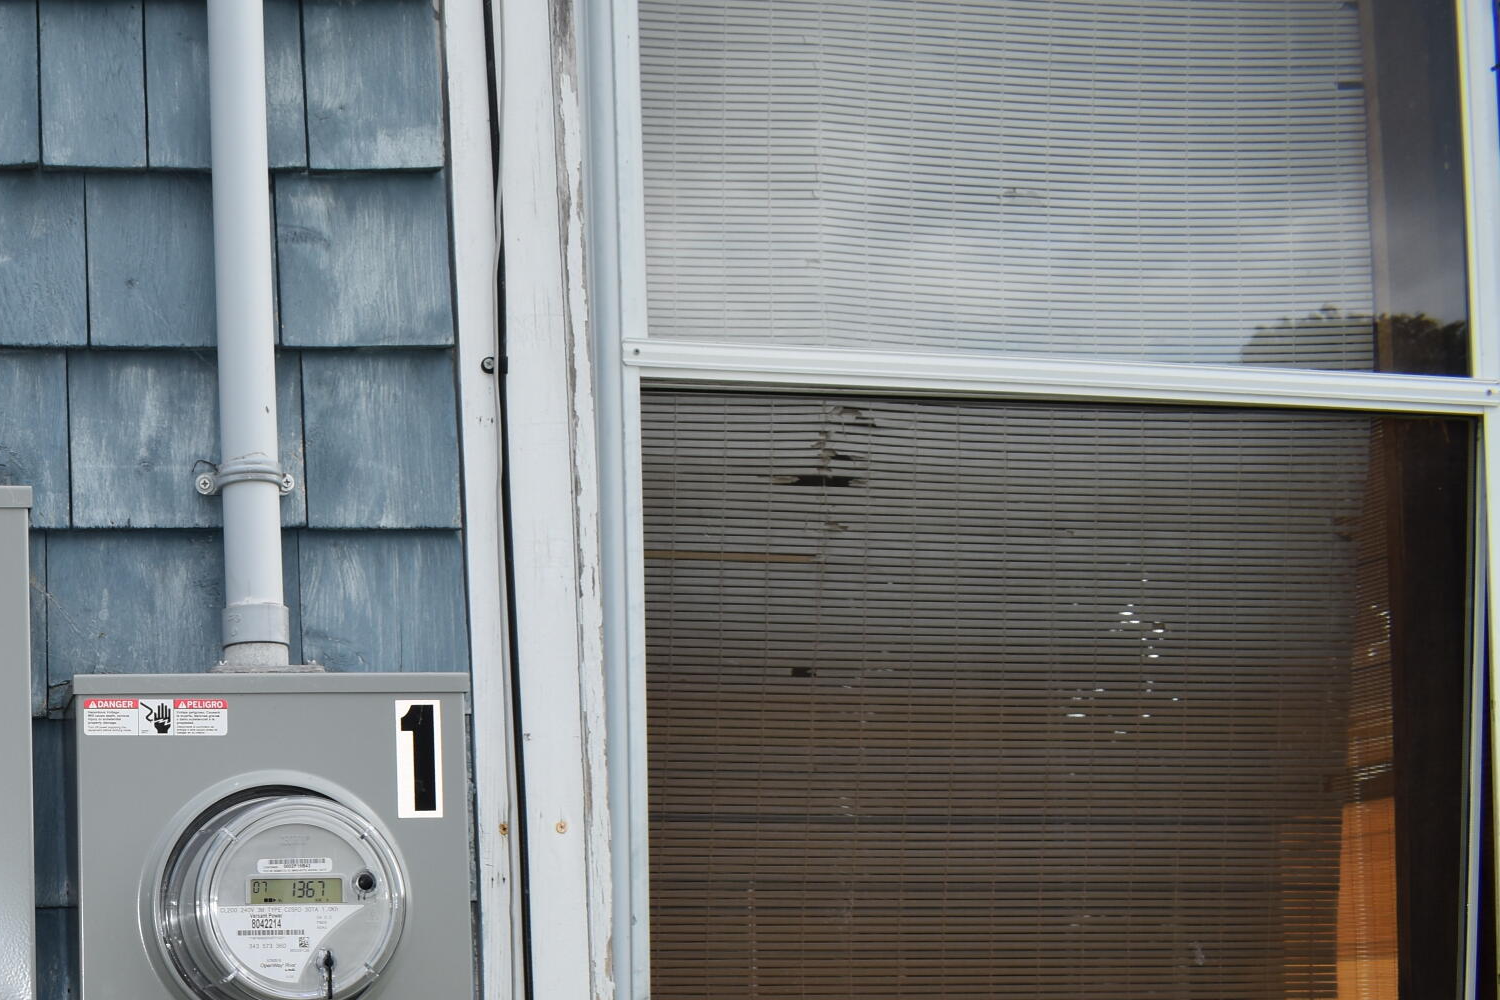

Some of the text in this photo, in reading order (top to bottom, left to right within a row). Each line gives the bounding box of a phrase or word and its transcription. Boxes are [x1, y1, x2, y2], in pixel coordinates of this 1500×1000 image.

[97, 700, 133, 708] DANGER
[187, 700, 223, 708] PELIGRO
[399, 704, 437, 812] 1
[253, 881, 325, 898] 07 1367
[252, 919, 282, 928] 8042214
